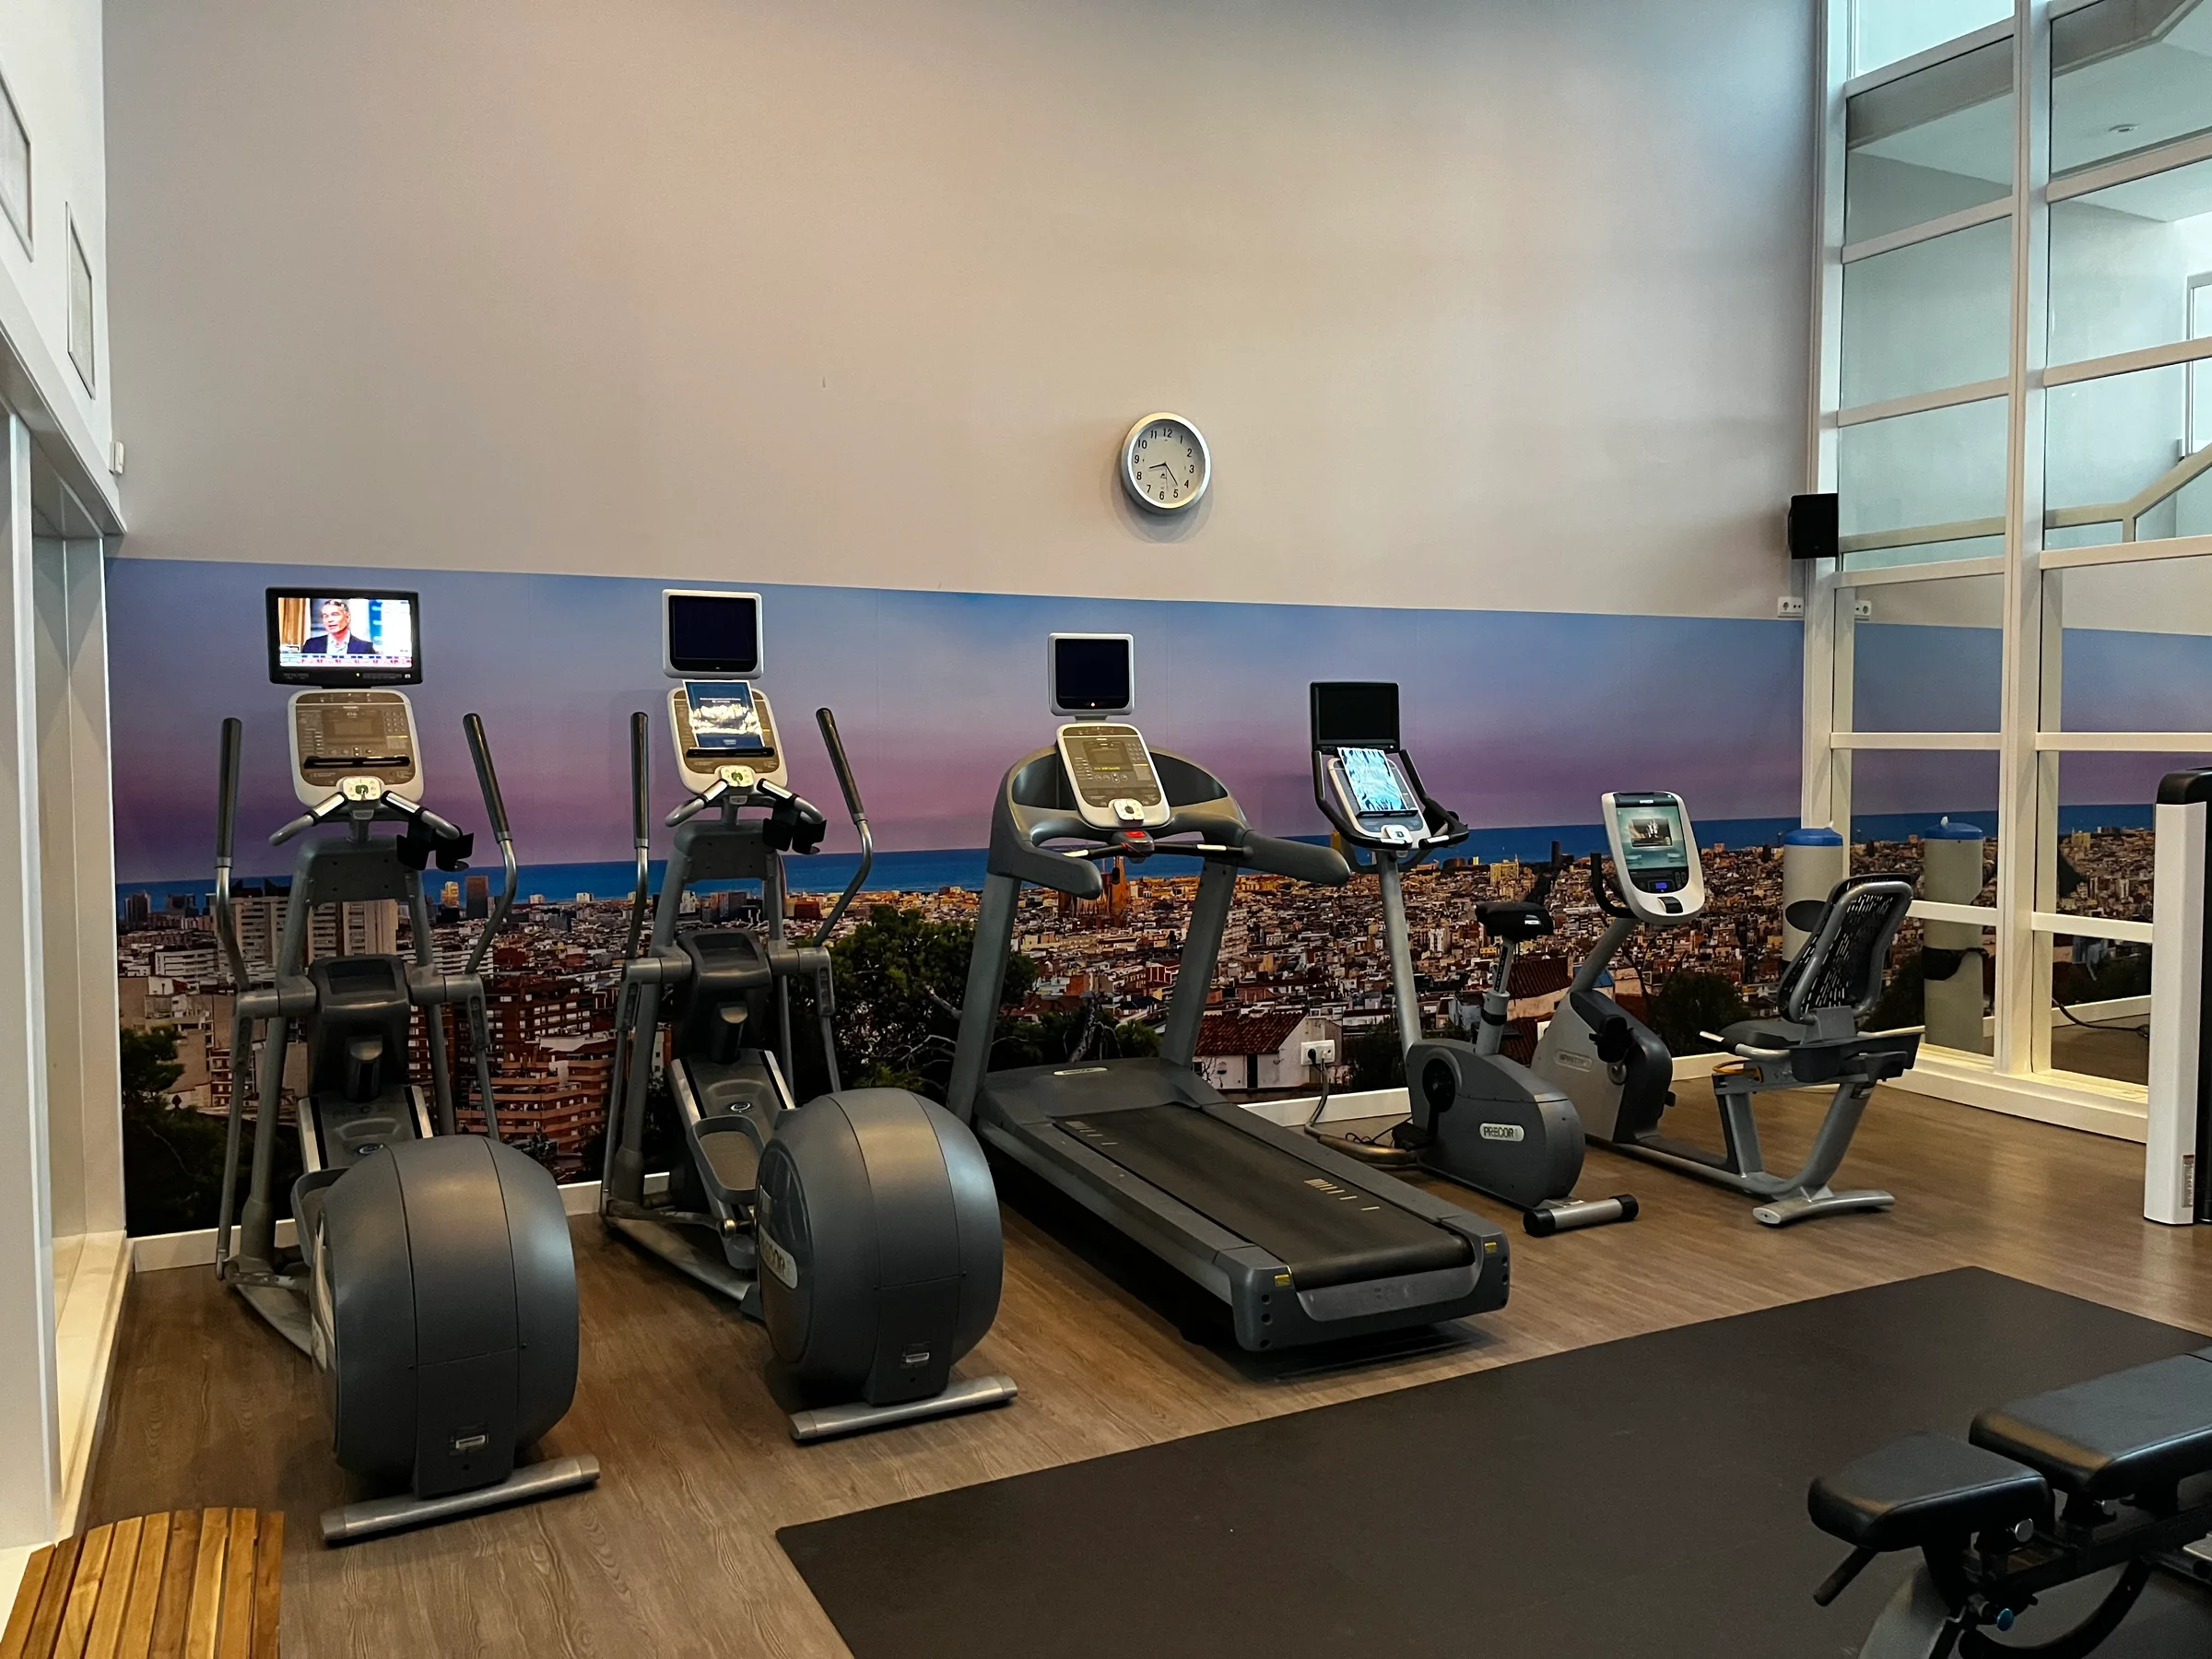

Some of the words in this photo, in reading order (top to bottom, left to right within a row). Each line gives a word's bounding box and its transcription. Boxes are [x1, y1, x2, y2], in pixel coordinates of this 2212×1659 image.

[1150, 429, 1158, 440] 11
[1162, 428, 1172, 438] 12
[1137, 439, 1147, 449] 10
[1180, 435, 1183, 444] 1
[1186, 448, 1193, 457] 2
[1134, 455, 1139, 464] 9
[1189, 465, 1194, 474] 3
[1136, 471, 1142, 480] 8
[1184, 479, 1189, 488] 4
[1147, 484, 1151, 493] 7
[1159, 491, 1165, 500] 6
[1172, 489, 1178, 498] 5
[1483, 1126, 1514, 1138] PRECOR
